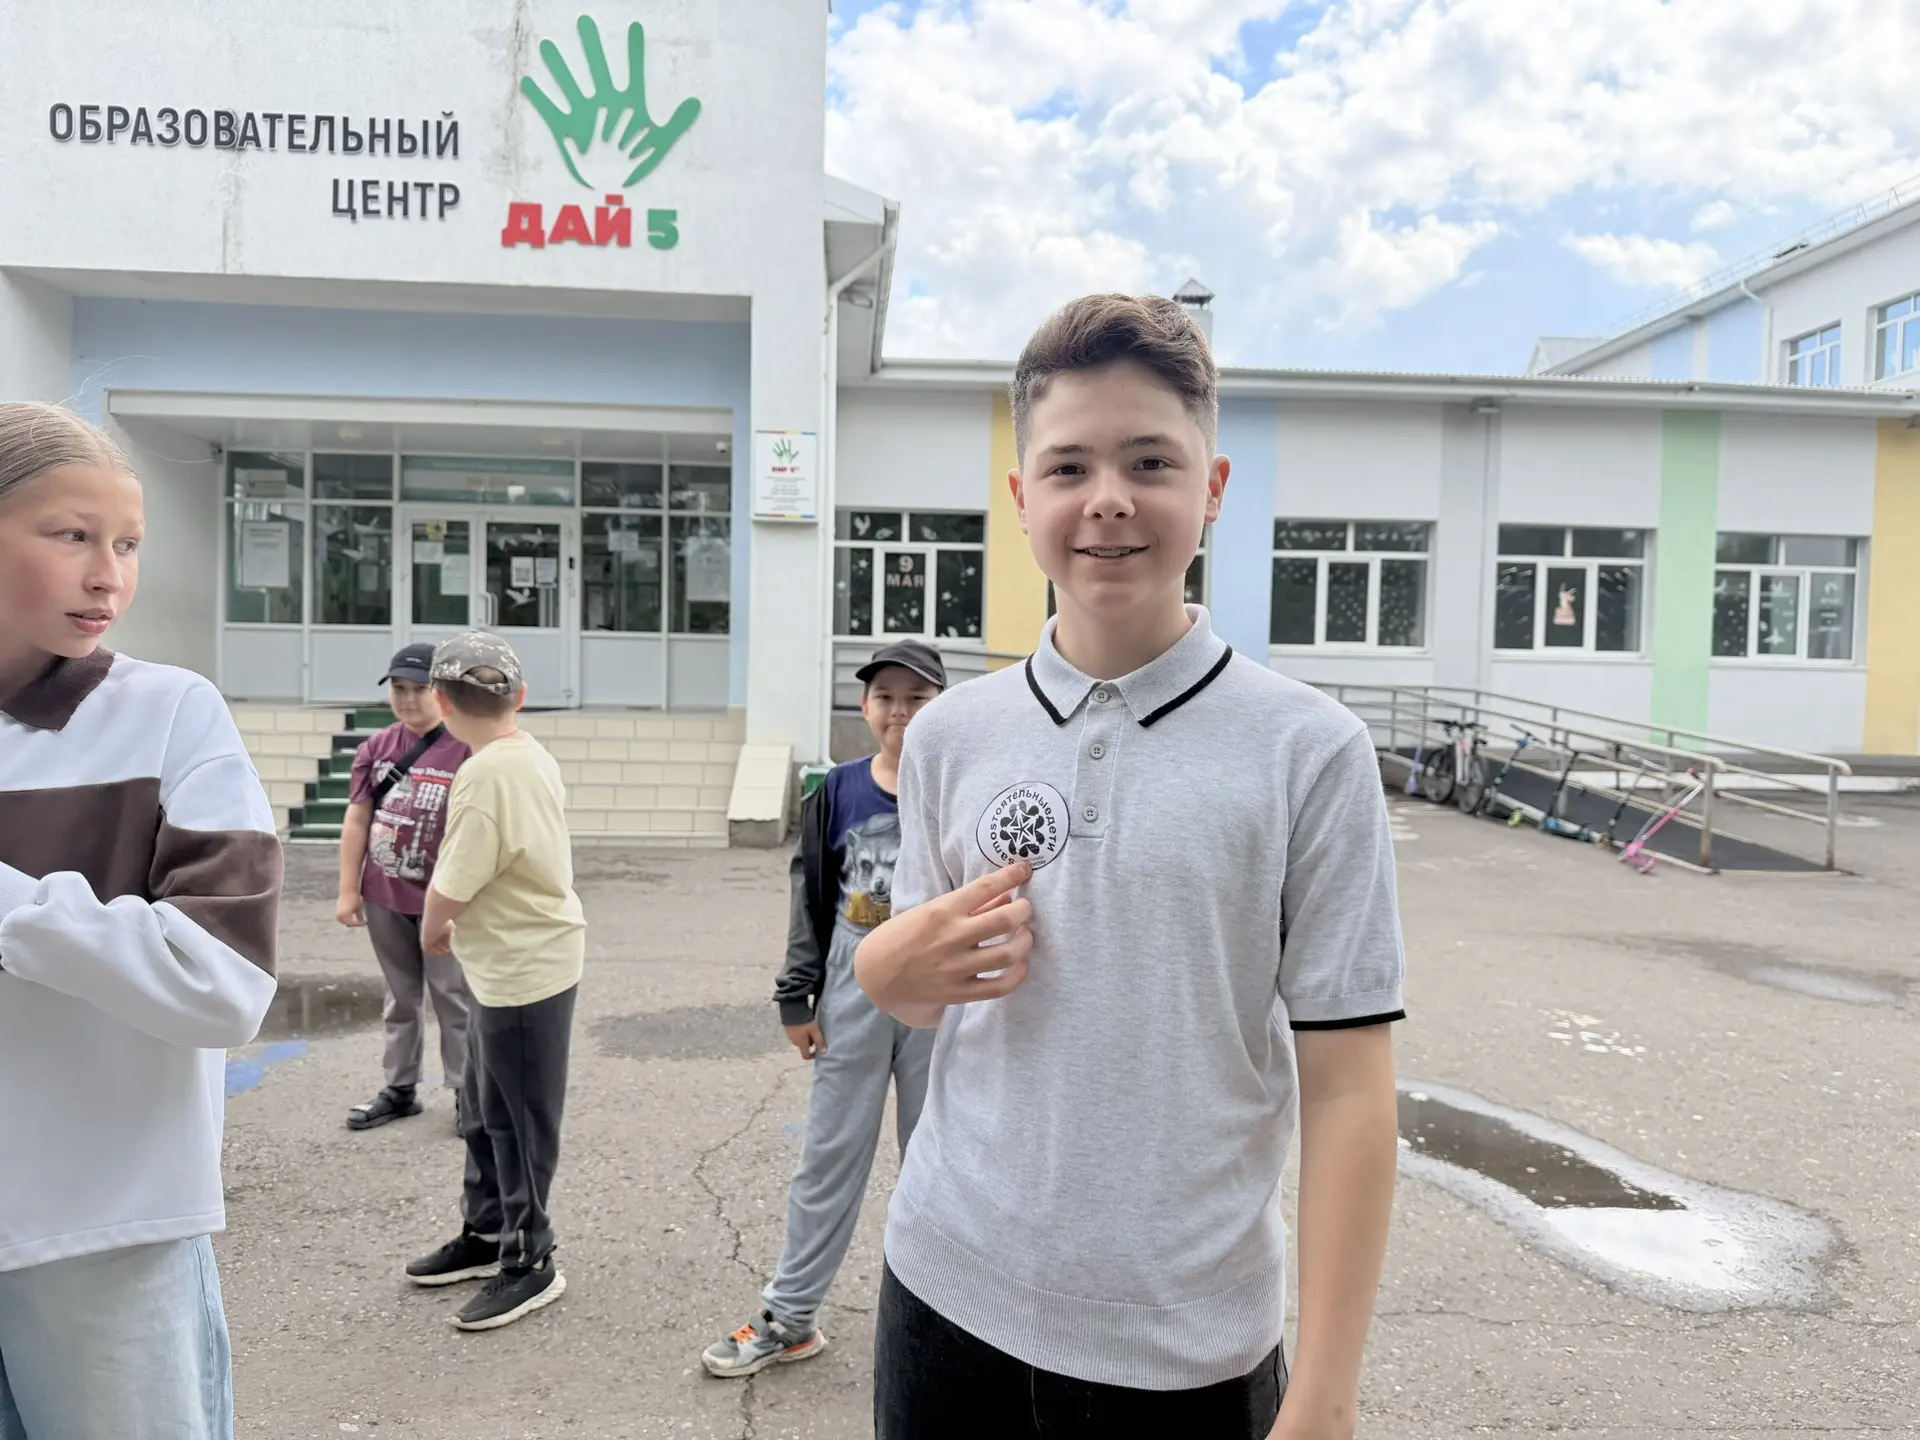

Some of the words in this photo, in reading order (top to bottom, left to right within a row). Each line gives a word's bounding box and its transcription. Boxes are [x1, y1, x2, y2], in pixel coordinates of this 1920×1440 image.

[49, 102, 460, 158] ОБРАЗОВАТЕЛЬНЫЙ
[332, 178, 461, 222] ЦЕНТР
[501, 194, 632, 249] ДАЙ
[646, 208, 680, 250] 5
[898, 555, 914, 573] 9
